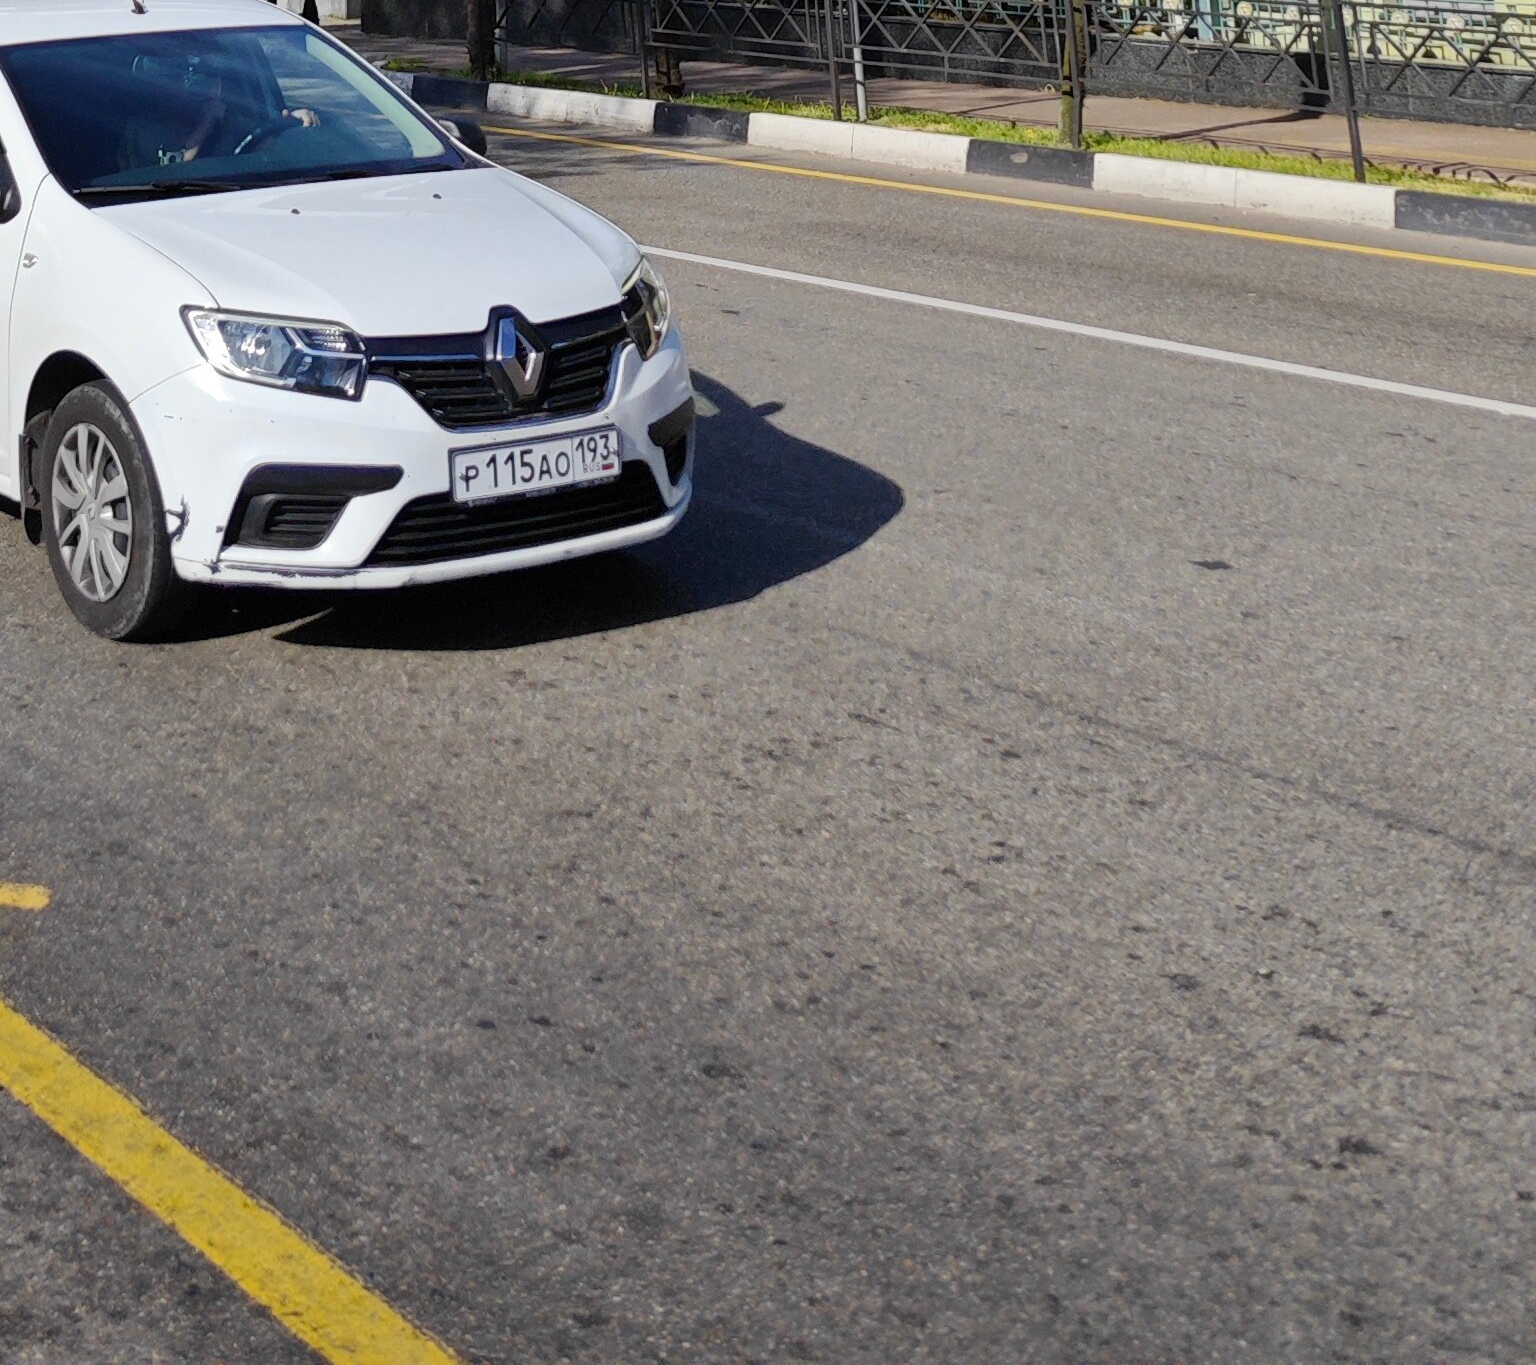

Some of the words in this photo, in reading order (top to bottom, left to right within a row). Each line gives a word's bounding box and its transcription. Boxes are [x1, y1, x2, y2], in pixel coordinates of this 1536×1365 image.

[464, 448, 571, 492] Р115АО
[575, 433, 611, 464] 193
[583, 462, 601, 473] RUS
